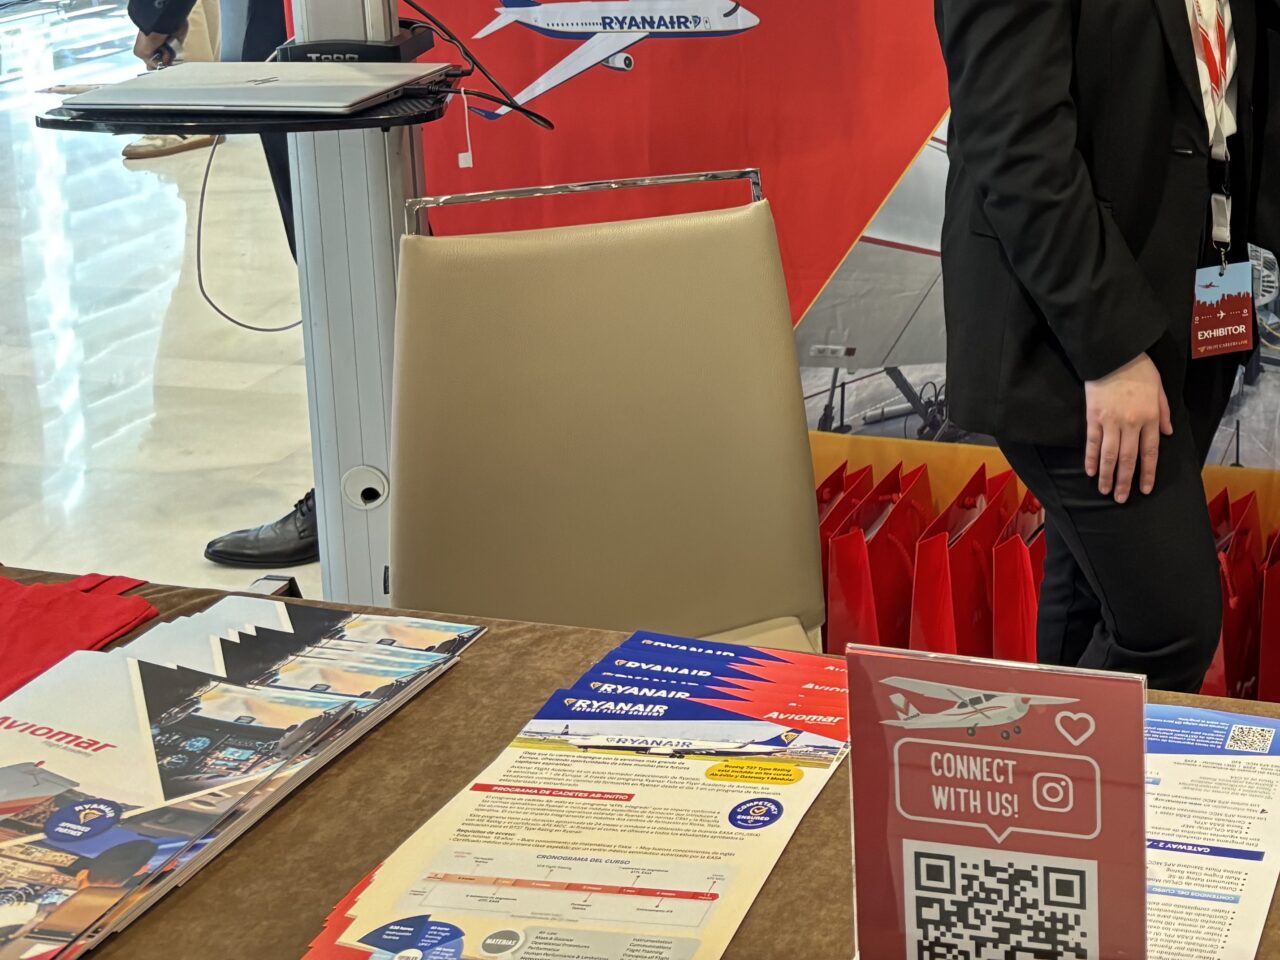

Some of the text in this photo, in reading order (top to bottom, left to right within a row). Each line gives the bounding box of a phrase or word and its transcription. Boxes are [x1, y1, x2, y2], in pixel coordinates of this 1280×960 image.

[601, 13, 691, 30] RYANAIR
[1198, 324, 1246, 340] EXHIBITOR
[601, 682, 691, 700] RYANAIR
[576, 698, 669, 714] RYANAIR
[763, 711, 845, 725] Aviomar
[614, 737, 693, 748] RYANAIR
[931, 751, 1017, 785] CONNECT
[491, 786, 538, 794] PROGRAMA
[552, 790, 590, 798] CADETES
[737, 800, 778, 815] COMPETENCY
[932, 785, 1020, 818] WITH US!
[1165, 843, 1211, 853] GATEWAY
[536, 854, 589, 863] CRONOGRAMA
